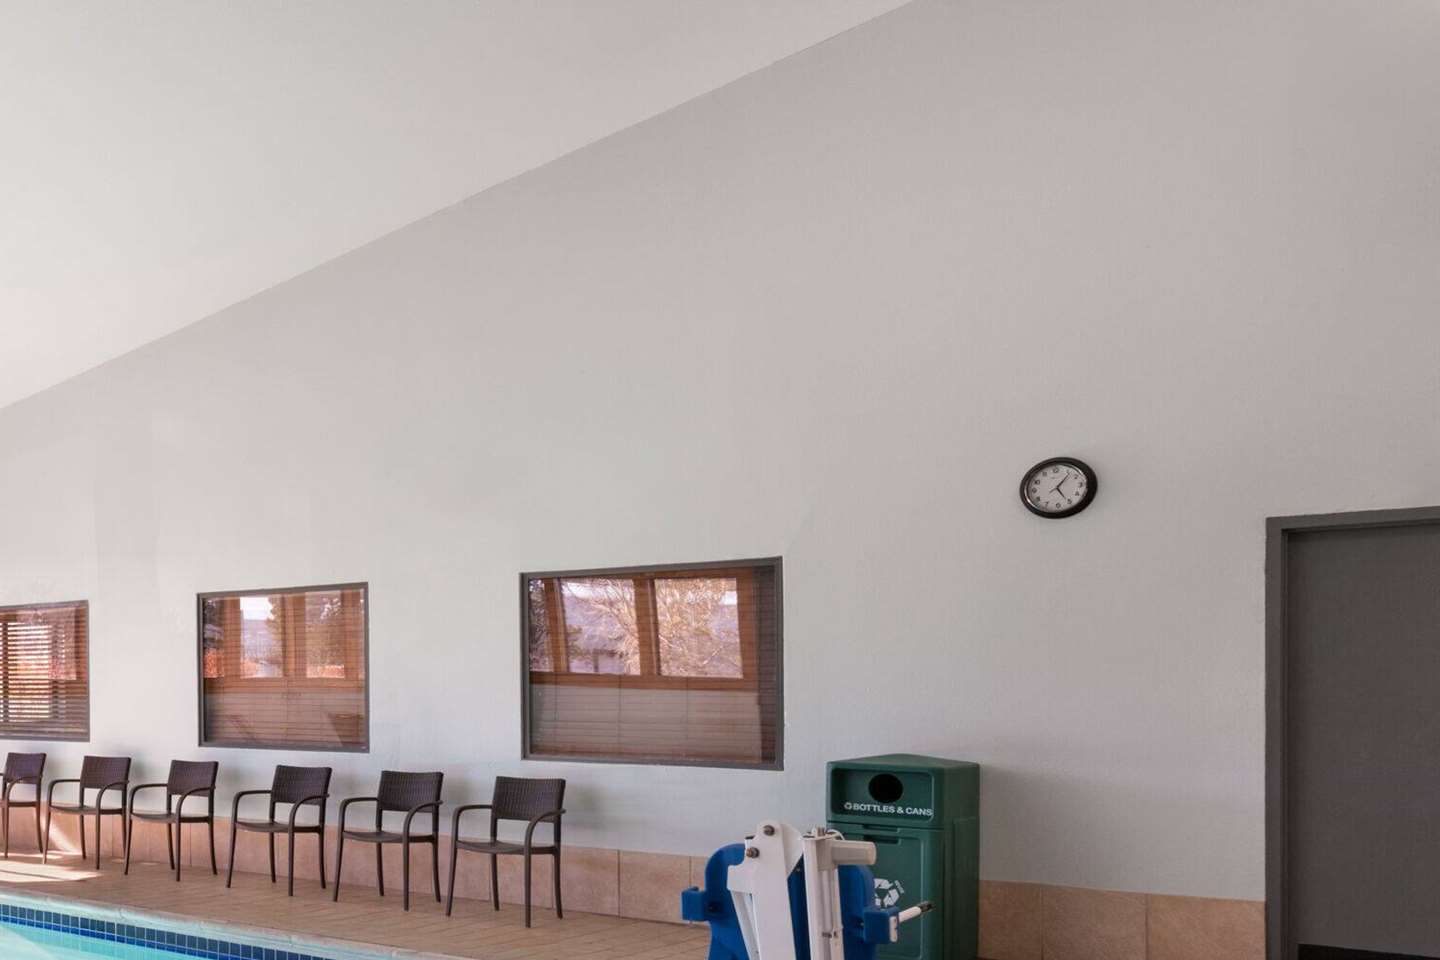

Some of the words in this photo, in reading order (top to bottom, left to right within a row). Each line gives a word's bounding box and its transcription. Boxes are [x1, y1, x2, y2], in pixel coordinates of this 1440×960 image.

[853, 802, 895, 813] BOTTLES
[896, 806, 904, 814] &
[905, 807, 934, 816] CANS
